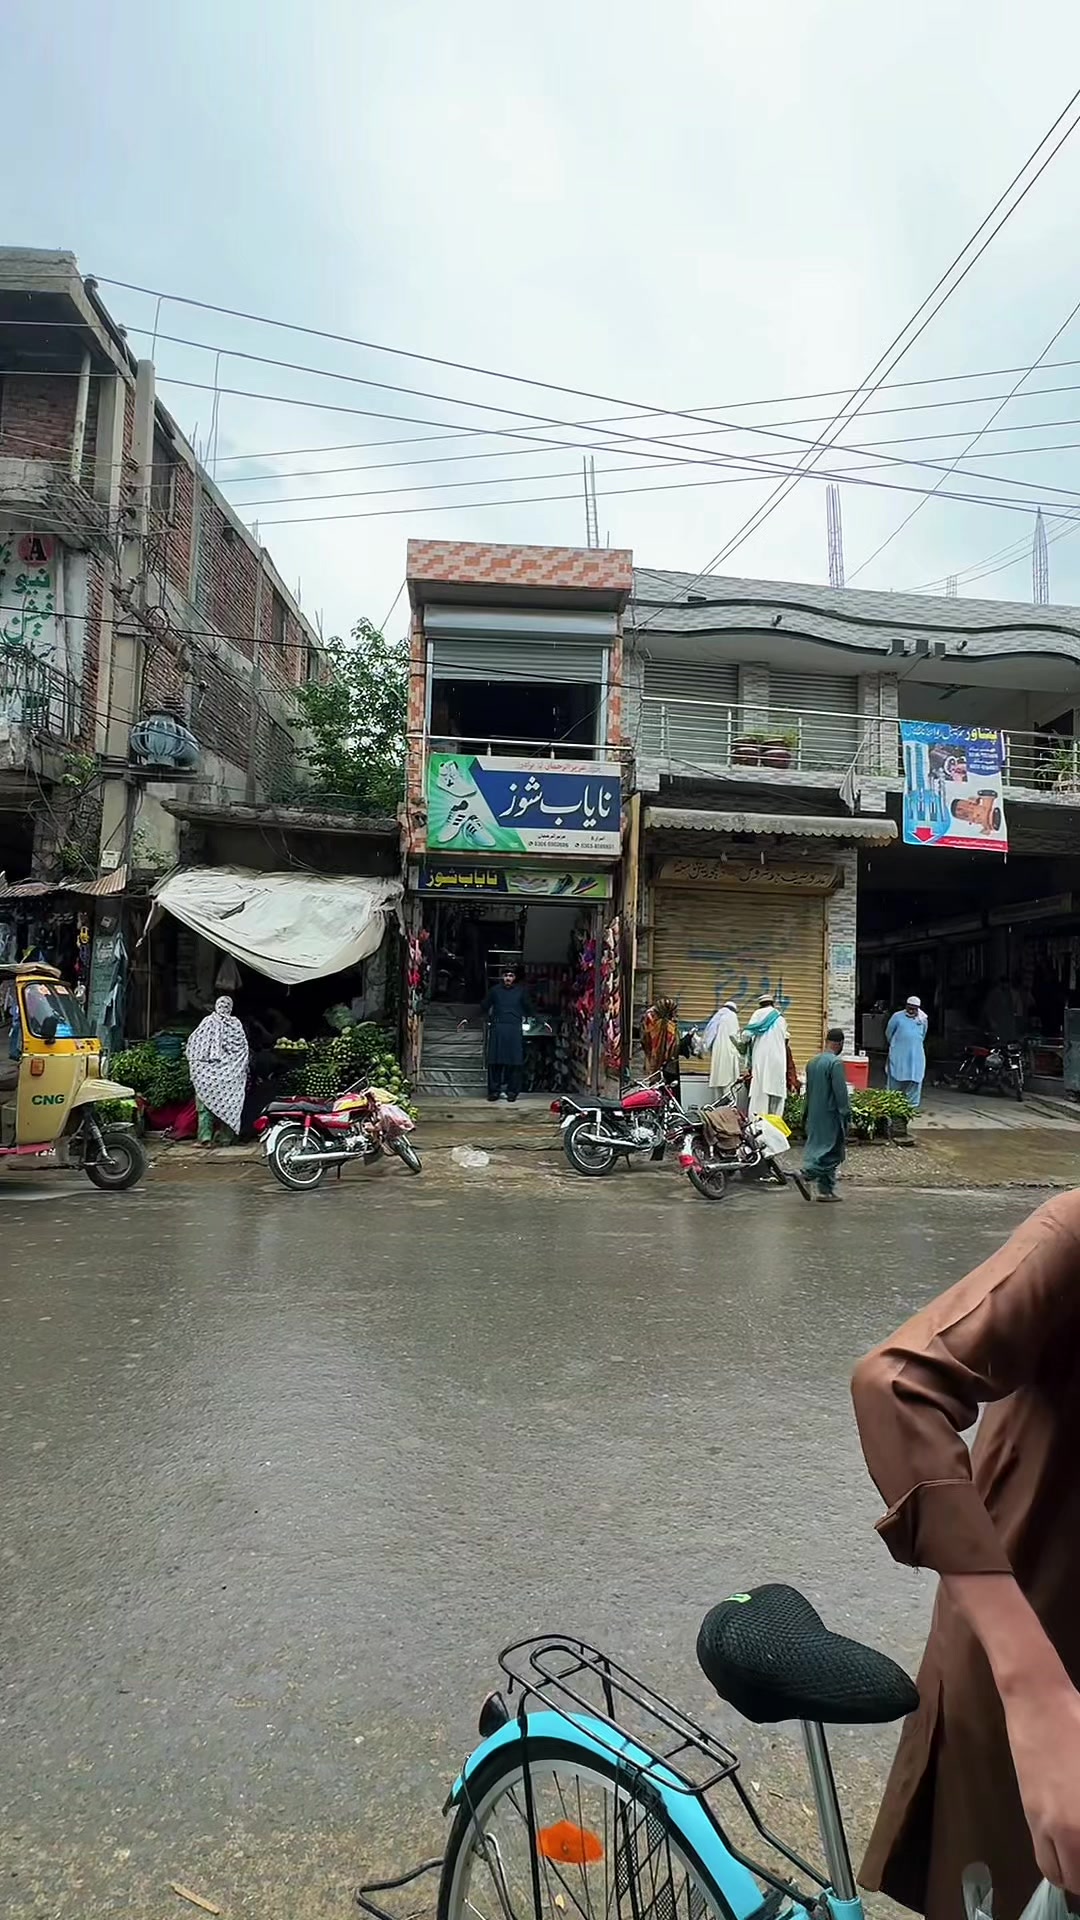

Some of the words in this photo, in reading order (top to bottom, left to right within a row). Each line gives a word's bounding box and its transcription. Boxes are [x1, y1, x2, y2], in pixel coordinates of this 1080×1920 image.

[965, 727, 998, 745] پشاور
[499, 775, 542, 817] شوز
[540, 784, 612, 828] نایاب
[426, 868, 458, 887] شوز
[458, 869, 498, 888] نایاب
[32, 1094, 65, 1105] CNG
